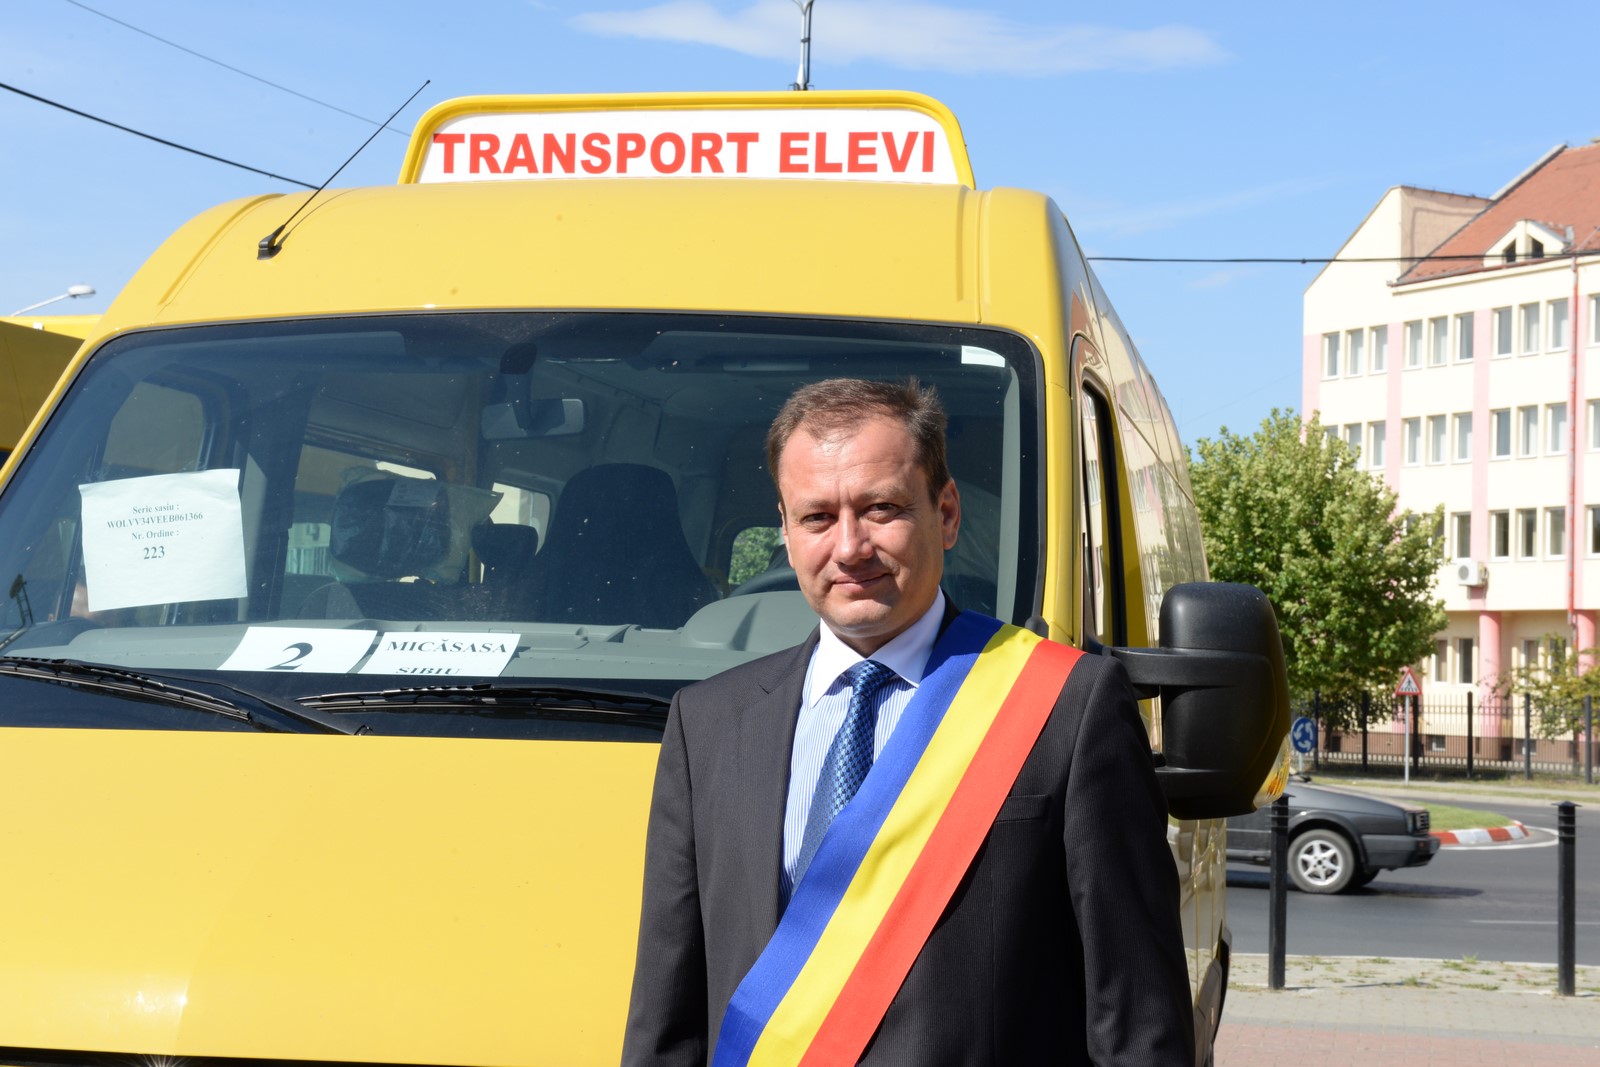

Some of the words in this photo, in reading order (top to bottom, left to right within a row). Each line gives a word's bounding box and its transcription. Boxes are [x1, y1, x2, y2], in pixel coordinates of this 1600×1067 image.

[433, 132, 760, 175] TRANSPORT
[778, 131, 936, 174] ELEVI
[132, 506, 153, 514] Serie
[154, 503, 175, 512] sasiu
[131, 532, 145, 541] Nr.
[146, 530, 175, 539] Ordine
[143, 545, 165, 560] 223
[387, 638, 507, 653] MICĂSASA
[265, 642, 313, 671] 2
